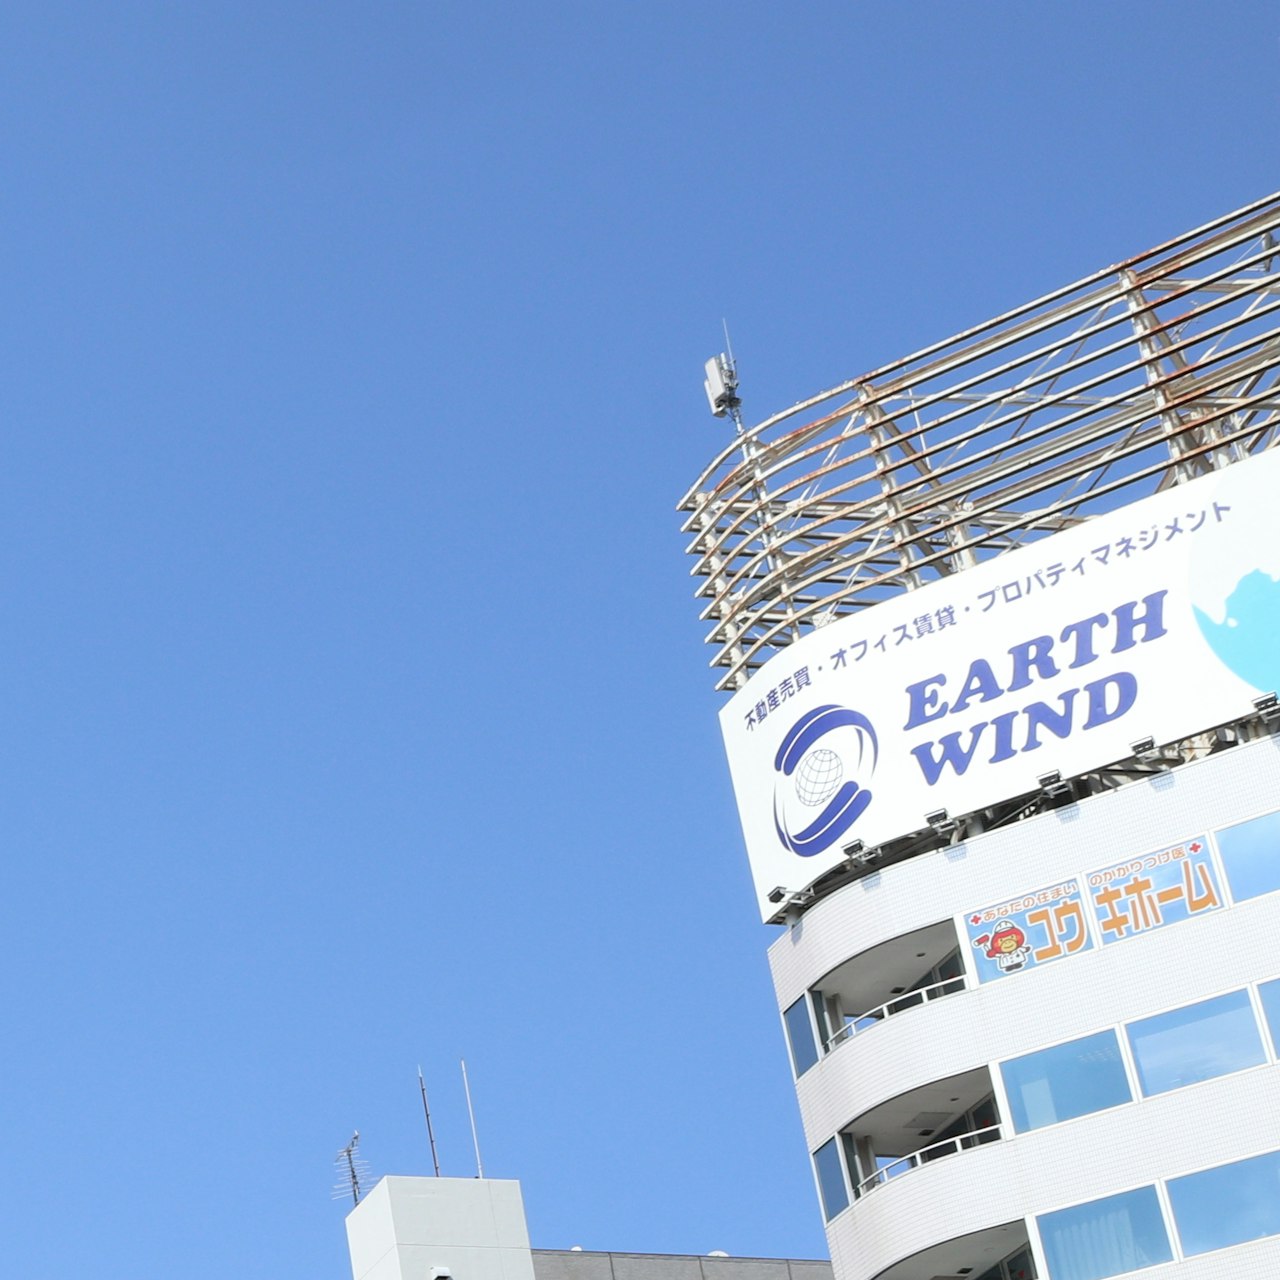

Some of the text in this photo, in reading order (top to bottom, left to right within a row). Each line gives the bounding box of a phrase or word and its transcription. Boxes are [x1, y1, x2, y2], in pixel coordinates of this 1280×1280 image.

[743, 501, 1231, 732] 不動産売買・オフィス賃貸・プロパティマネジメント
[902, 589, 1169, 732] EARTH
[911, 671, 1139, 787] WIND
